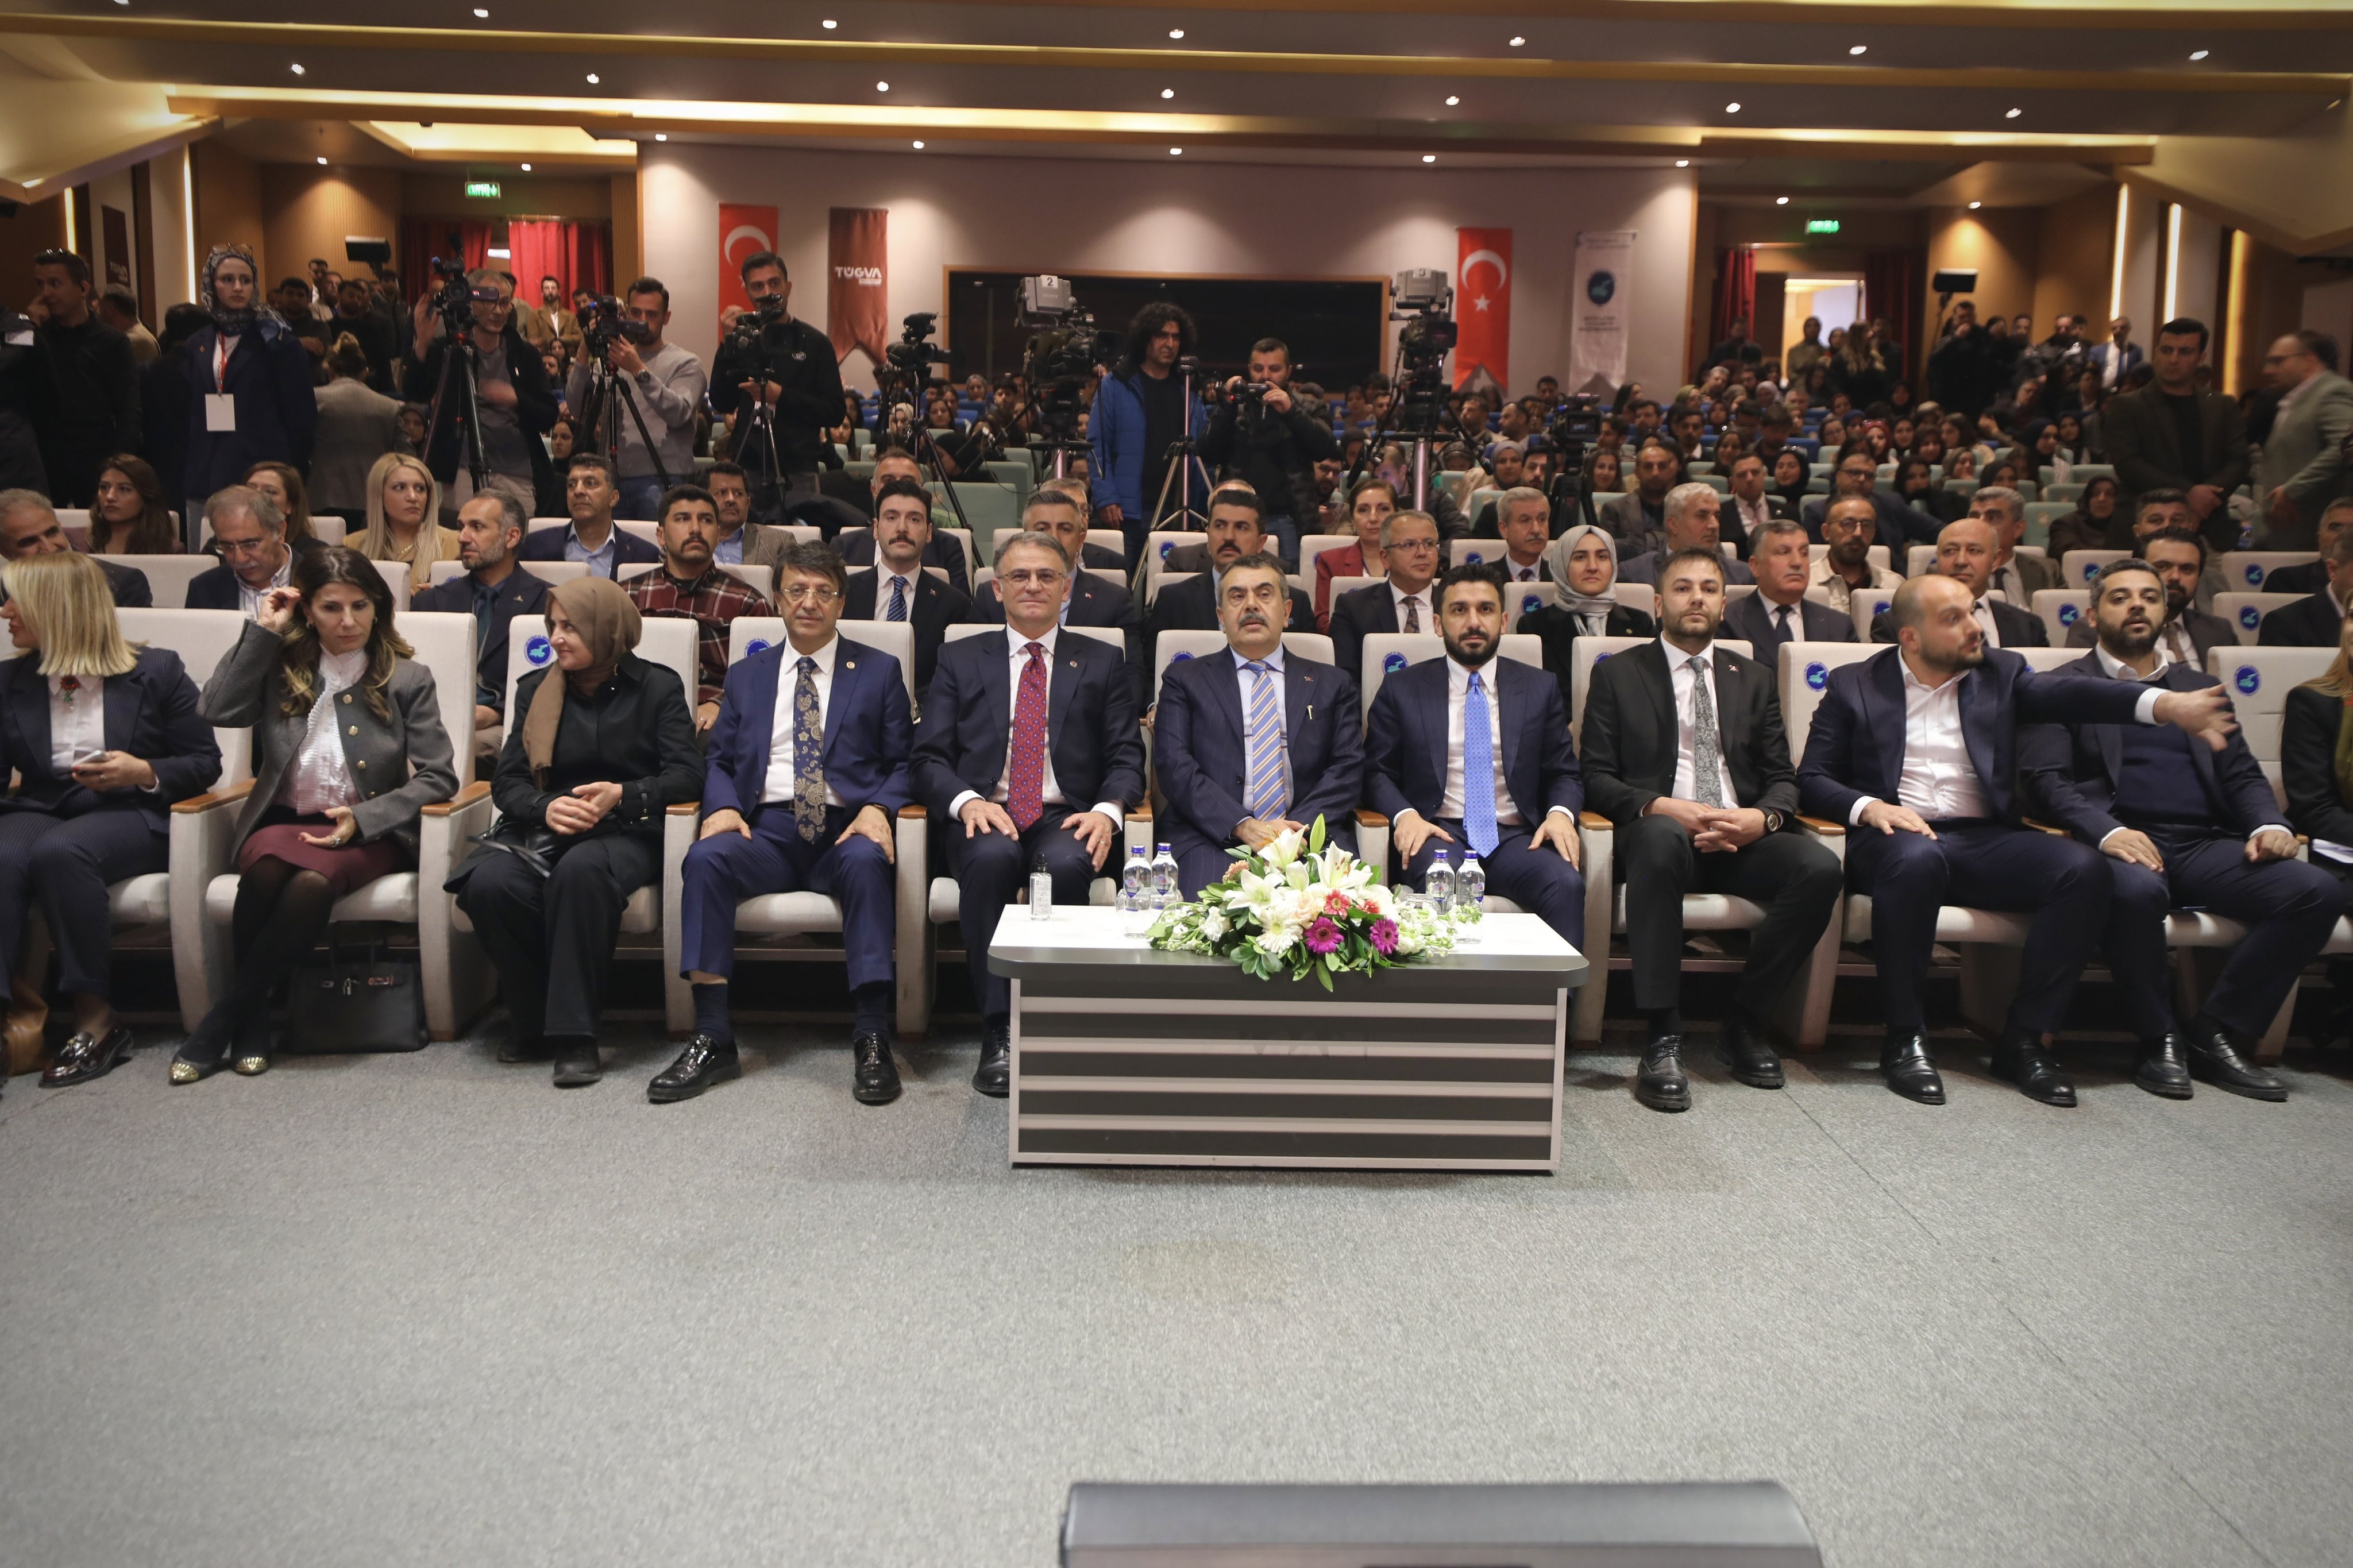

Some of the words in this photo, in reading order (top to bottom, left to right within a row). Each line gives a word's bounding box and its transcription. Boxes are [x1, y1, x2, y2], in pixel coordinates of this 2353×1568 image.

[835, 267, 882, 279] TÜGVA
[1419, 268, 1426, 276] 3
[1047, 277, 1053, 286] 2
